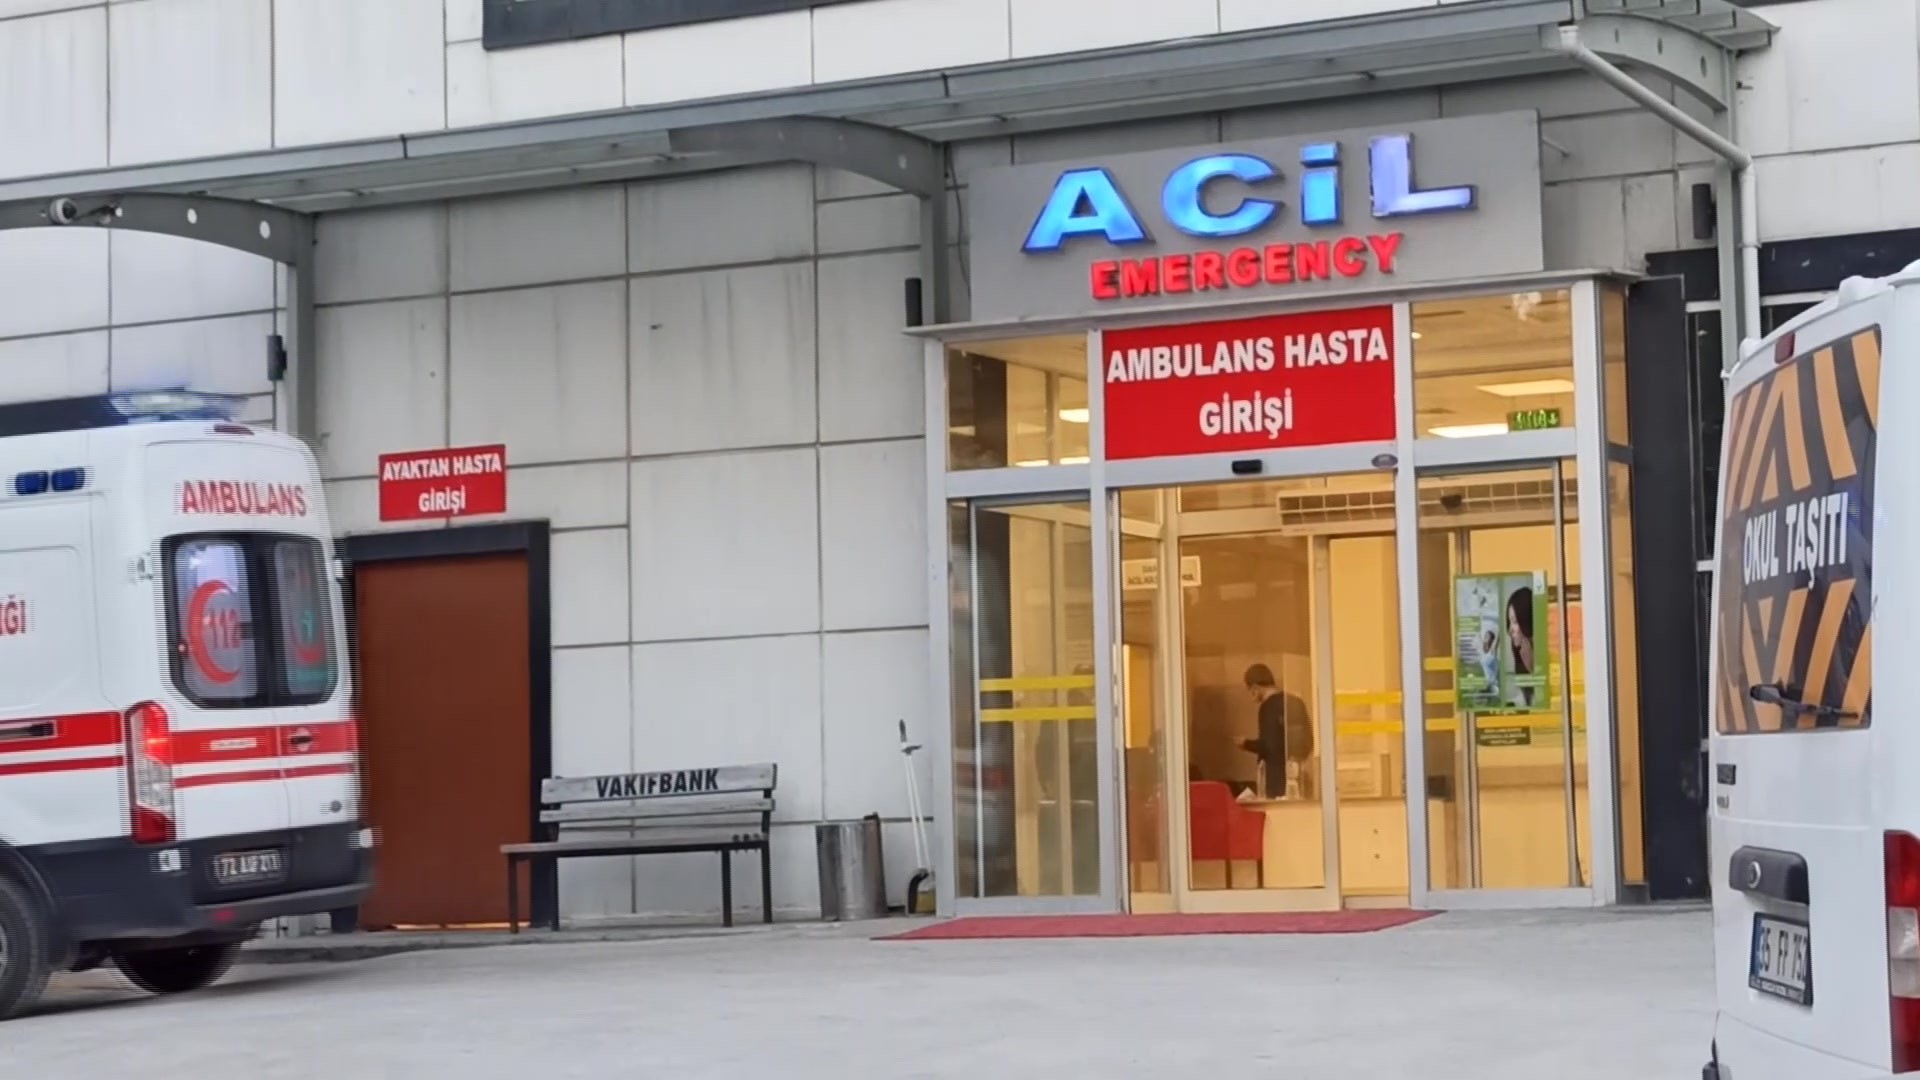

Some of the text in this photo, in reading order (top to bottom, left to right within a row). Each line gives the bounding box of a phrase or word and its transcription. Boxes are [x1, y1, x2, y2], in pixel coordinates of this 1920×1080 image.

[1090, 232, 1402, 300] EMERGENCY
[1106, 327, 1389, 383] AMBULANS HASTA
[1199, 387, 1293, 440] GİRİŞİ
[383, 452, 502, 481] AYAKTAN HASTA
[182, 480, 306, 517] AMBULANS
[418, 484, 466, 515] GİRİŞİ
[1744, 491, 1848, 589] OKUL TAŞITI
[595, 768, 719, 798] VAKIFBANK
